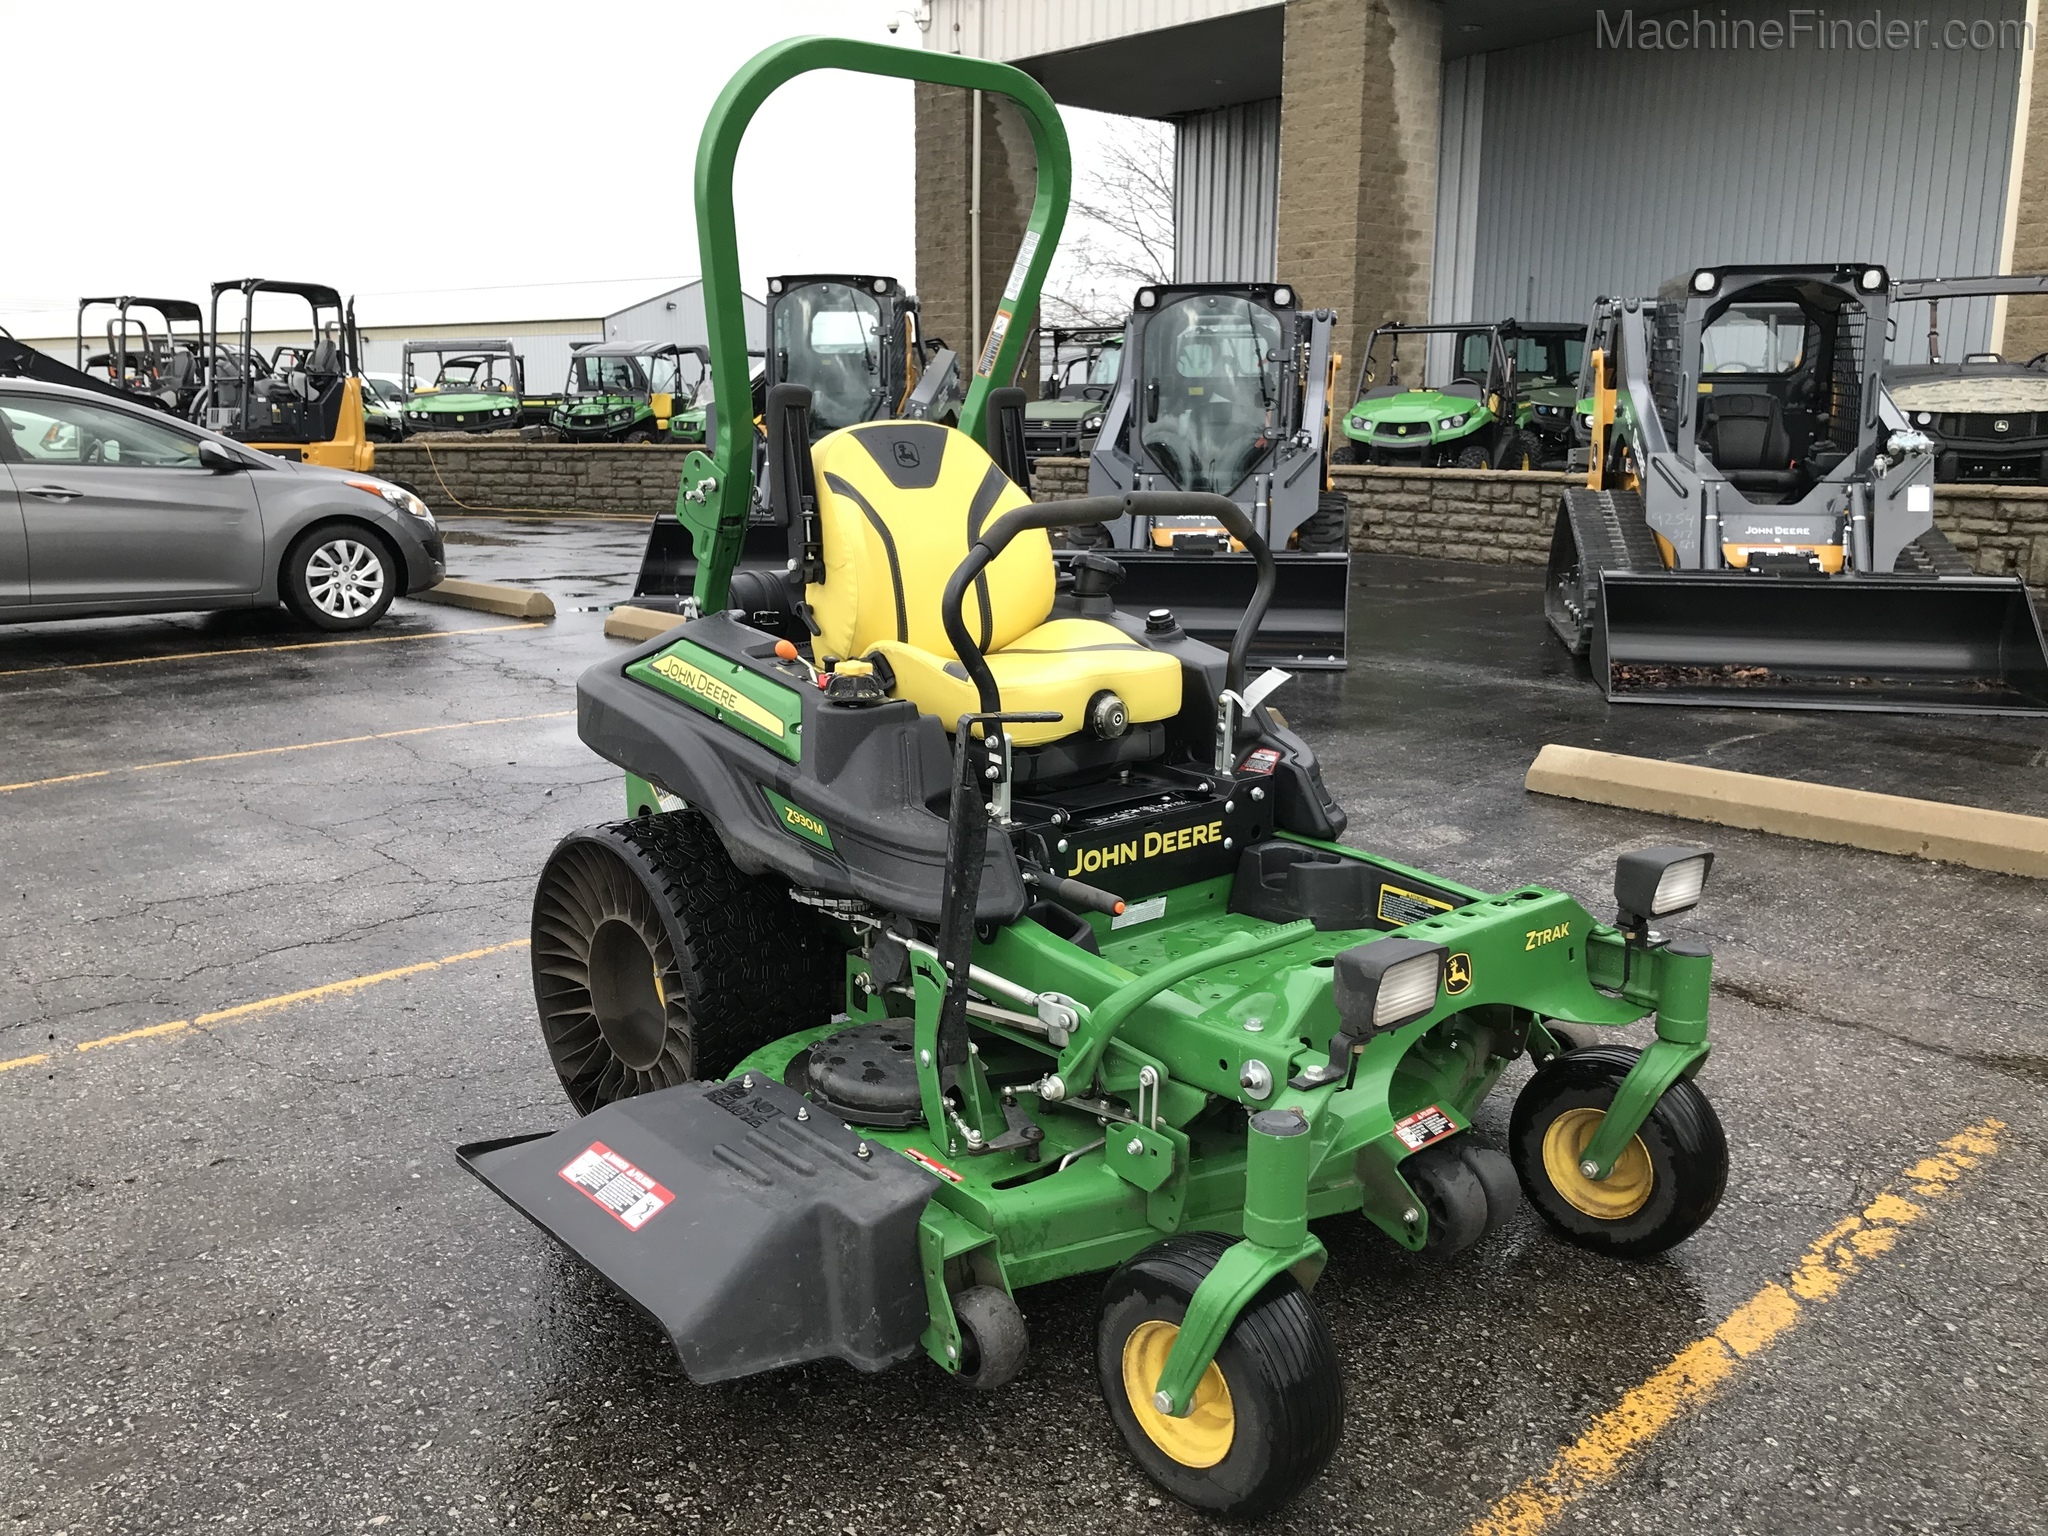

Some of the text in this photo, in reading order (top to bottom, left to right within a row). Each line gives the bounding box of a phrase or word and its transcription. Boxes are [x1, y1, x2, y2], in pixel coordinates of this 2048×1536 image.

[1745, 526, 1811, 536] JOHN DEERE
[663, 659, 738, 709] JOHN DEERE
[784, 805, 824, 836] Z930M
[1068, 820, 1223, 877] JOHN DEERE
[1525, 921, 1570, 951] ZTRAK
[702, 1089, 768, 1128] REMOVE
[747, 1097, 786, 1118] NOT
